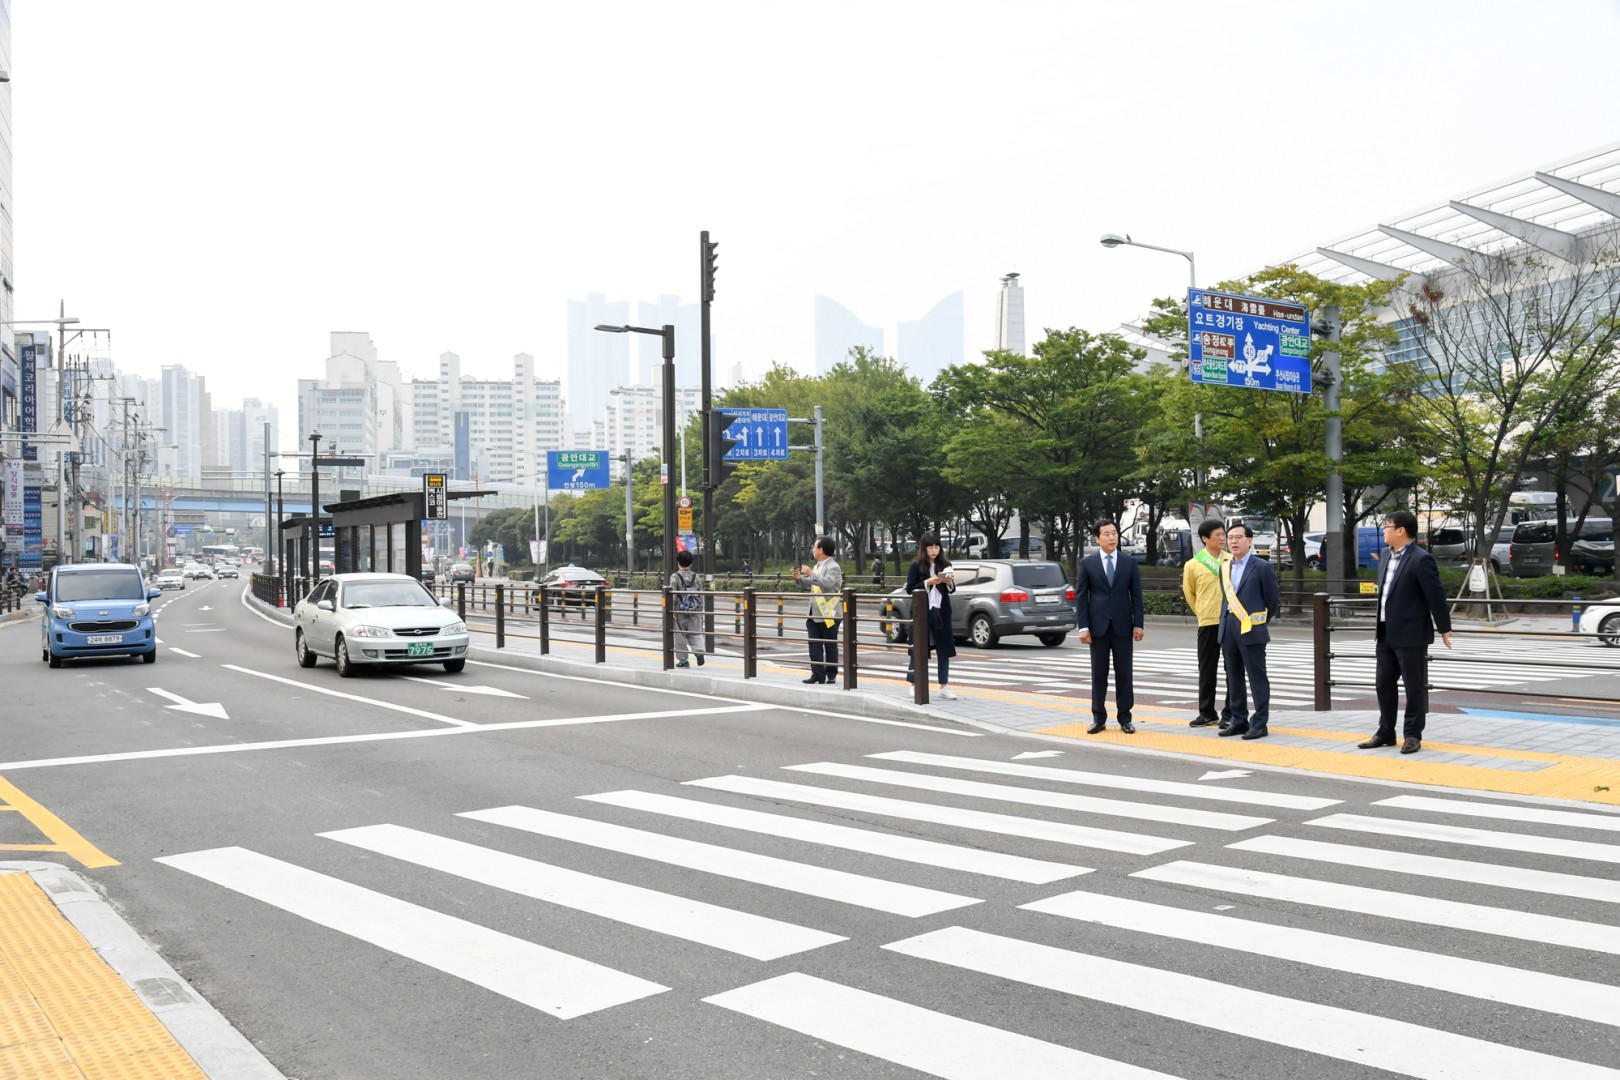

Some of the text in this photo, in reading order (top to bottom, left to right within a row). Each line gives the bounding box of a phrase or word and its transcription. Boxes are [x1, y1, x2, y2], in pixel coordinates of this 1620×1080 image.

[1204, 295, 1232, 311] 해운대
[1194, 312, 1300, 335] 요트경기장 Yachting Center
[1281, 335, 1308, 348] 광안대교
[1245, 347, 1254, 357] 40
[1236, 362, 1245, 372] 77
[561, 453, 596, 462] 광안대교
[735, 449, 750, 457] 2차로
[753, 449, 768, 457] 3차로
[770, 449, 785, 457] 4차로
[428, 488, 436, 506] 벡스코
[436, 488, 444, 518] 시립미술관
[409, 646, 433, 656] 7975
